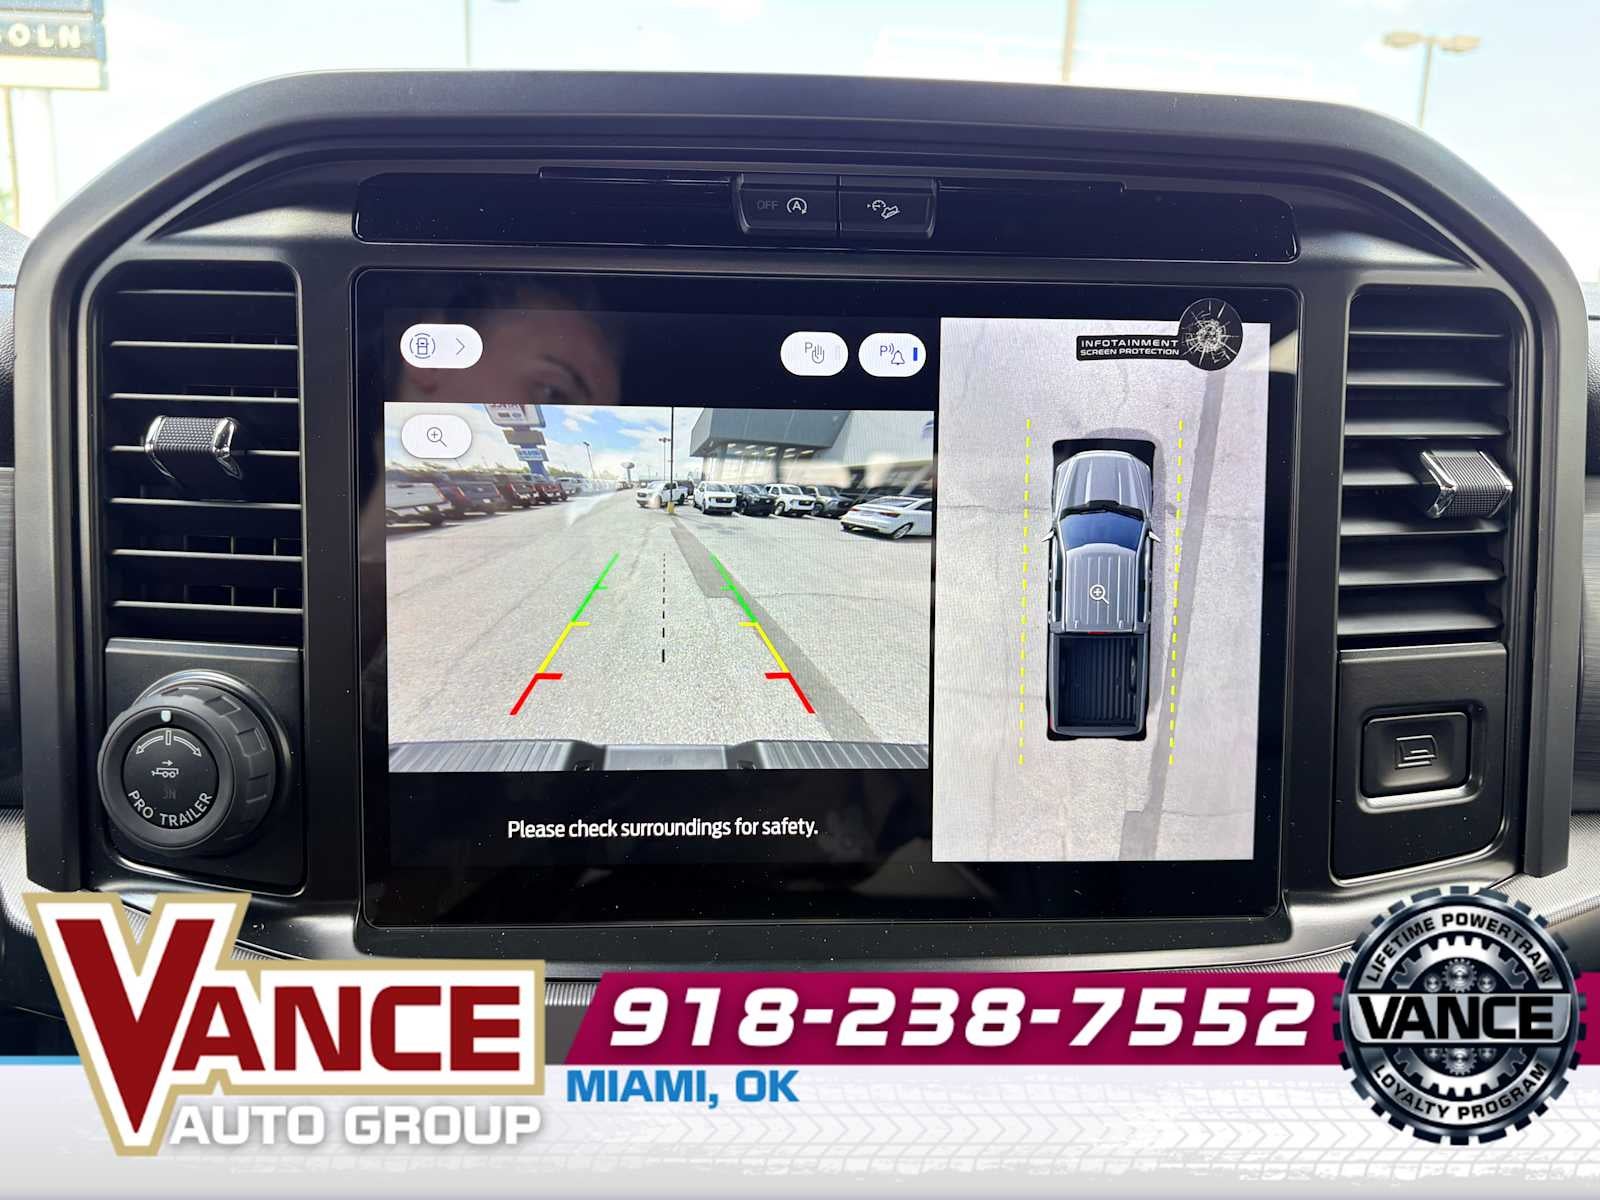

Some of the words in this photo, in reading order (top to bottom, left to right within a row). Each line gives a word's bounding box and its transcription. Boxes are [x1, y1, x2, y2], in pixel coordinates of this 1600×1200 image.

[0, 22, 81, 49] OLN
[1080, 348, 1117, 356] SCREEN
[1081, 339, 1179, 347] INFOTAINMENT
[128, 790, 154, 819] PRO
[159, 792, 213, 827] TRAILER
[507, 820, 565, 838] Please
[568, 819, 618, 837] check
[621, 818, 731, 839] surroundings
[734, 817, 759, 836] for
[762, 817, 819, 839] safety.
